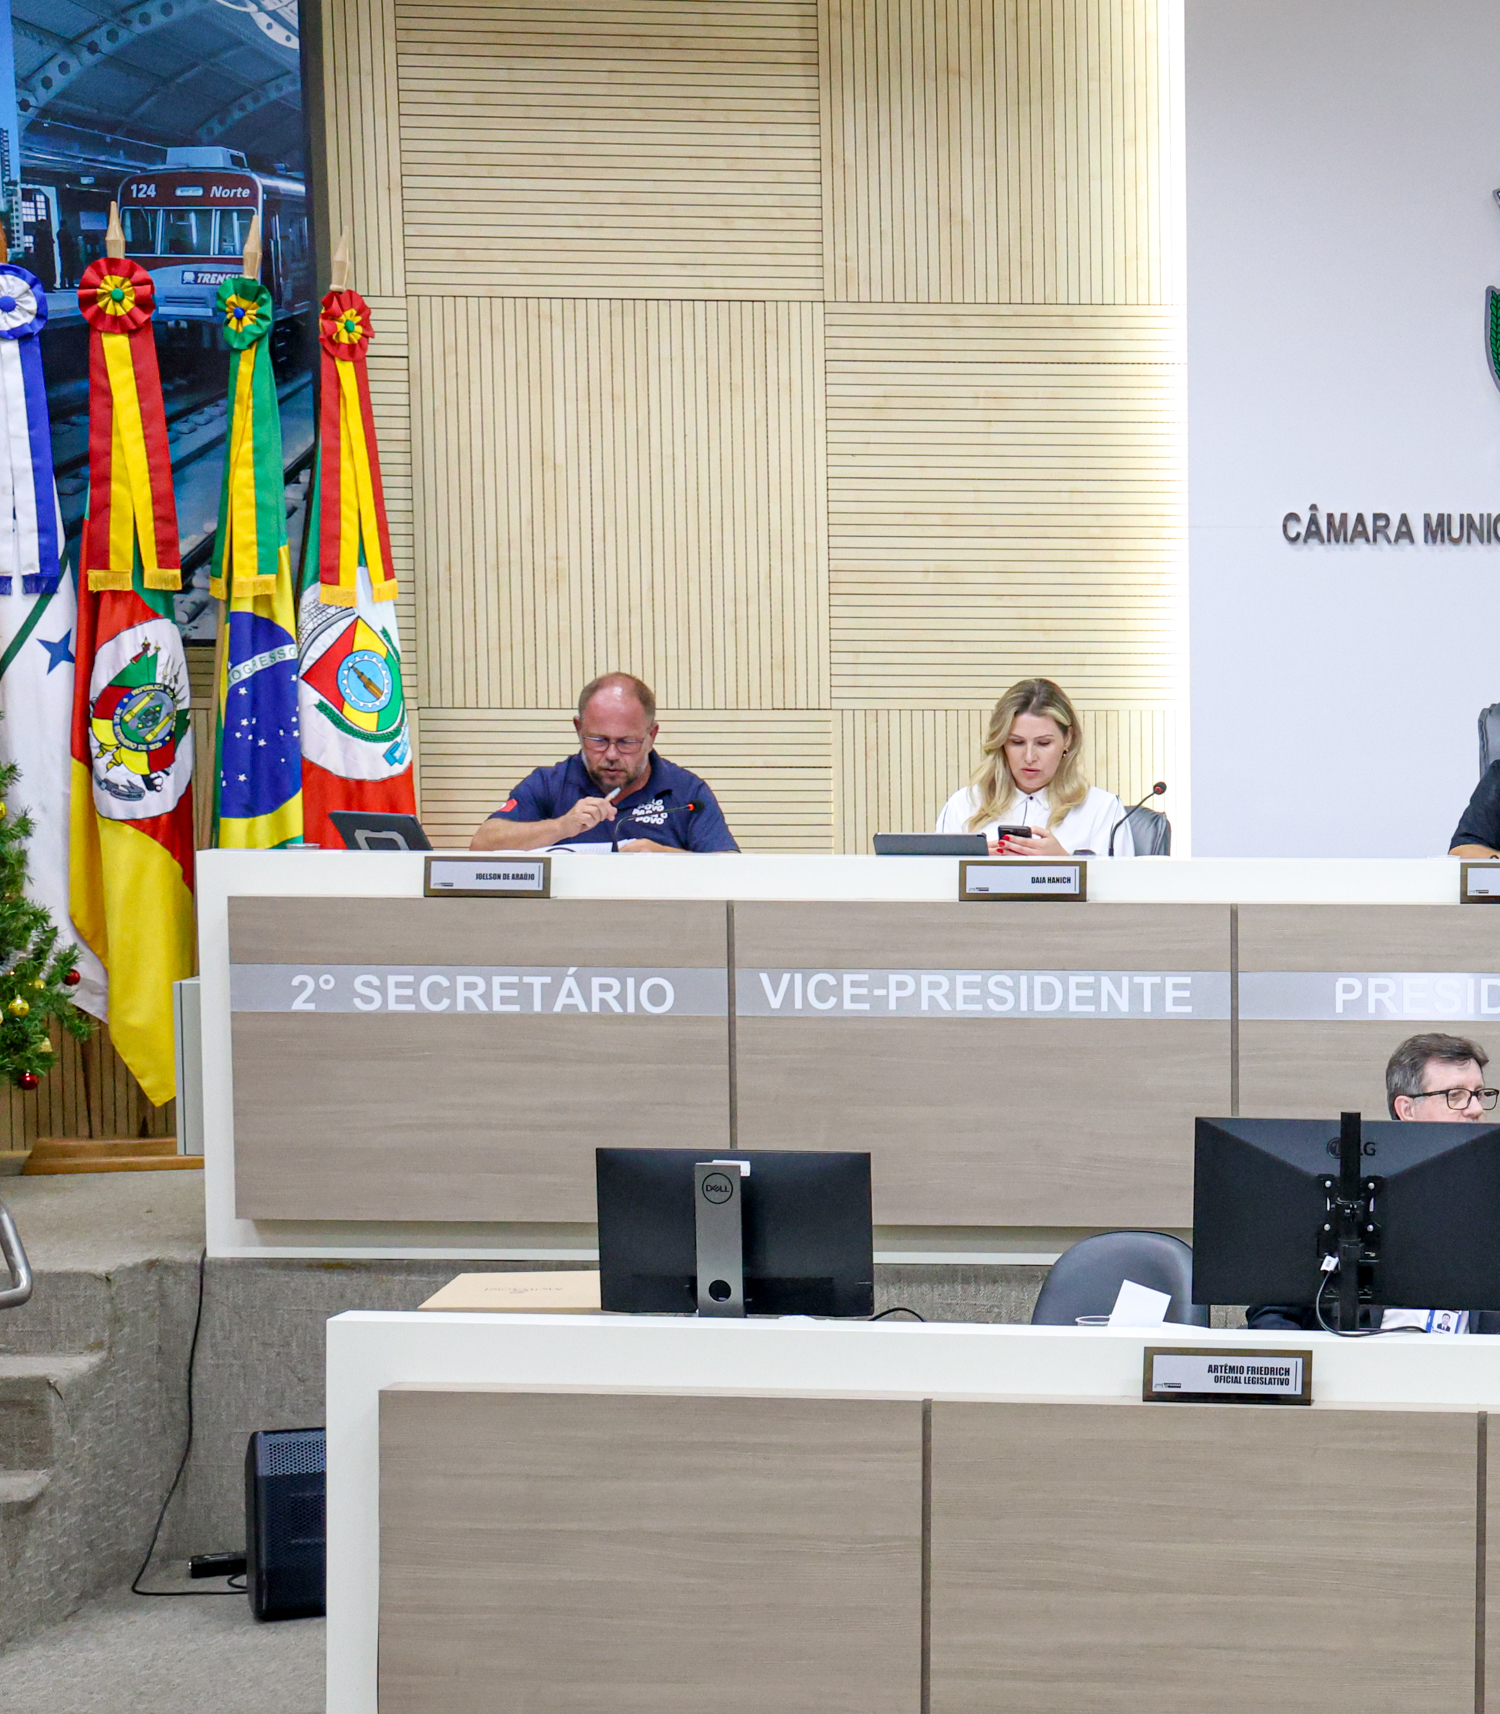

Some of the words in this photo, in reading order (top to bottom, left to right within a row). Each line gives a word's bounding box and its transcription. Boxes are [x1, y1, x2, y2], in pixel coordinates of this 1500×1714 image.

[130, 183, 157, 198] 124
[209, 185, 251, 198] Norte
[1282, 503, 1415, 545] CÂMARA
[228, 646, 298, 684] OGRESSO
[475, 872, 502, 881] JOELSON
[502, 872, 510, 881] DE
[511, 872, 535, 881] ARAÚJO
[1031, 876, 1047, 884] DAIA
[1047, 876, 1072, 884] HANICH
[290, 974, 336, 1011] 2°
[352, 967, 675, 1014] SECRETÁRIO
[758, 972, 1193, 1013] VICE-PRESIDENTE
[705, 1184, 730, 1193] DELL
[1207, 1363, 1245, 1375] ARTÊMIO
[1246, 1365, 1291, 1377] FRIEDRICH
[1213, 1375, 1242, 1384] OFICIAL
[1243, 1375, 1290, 1386] LEGISLATIVO
